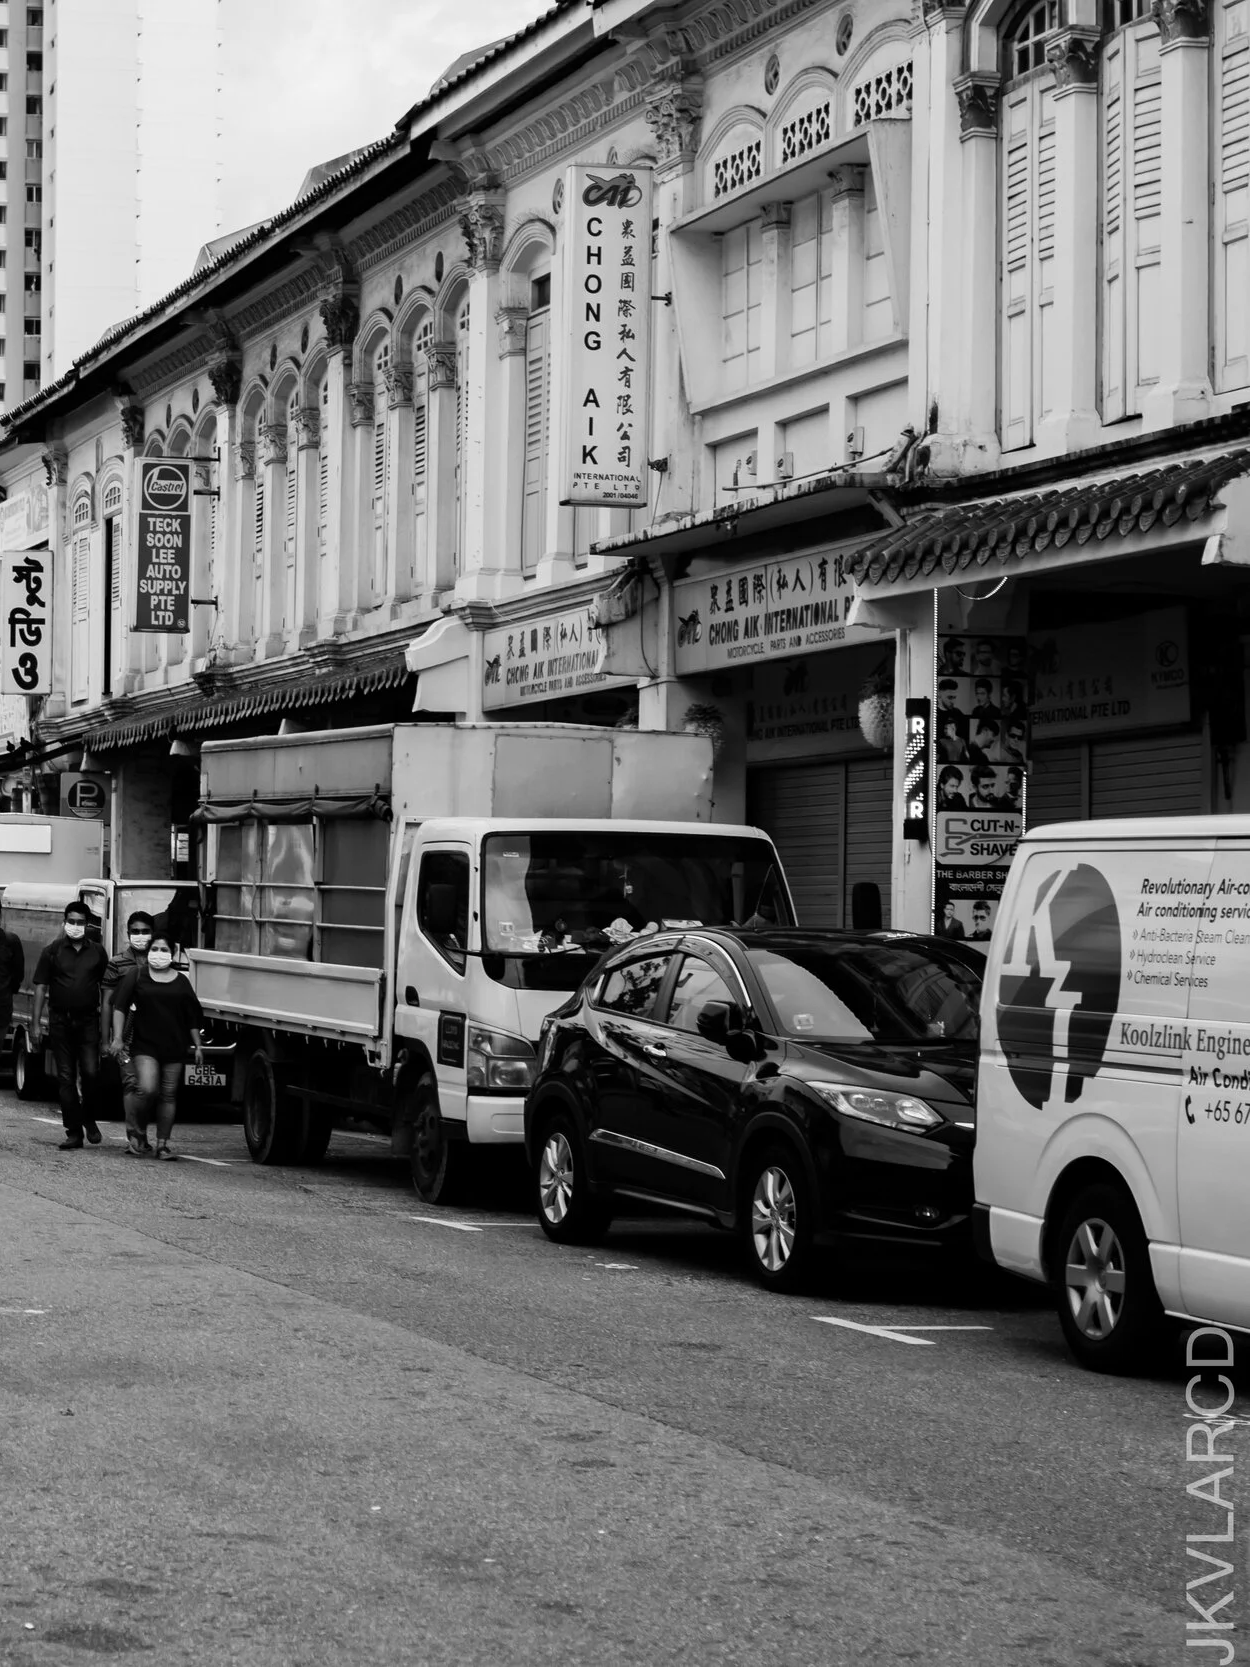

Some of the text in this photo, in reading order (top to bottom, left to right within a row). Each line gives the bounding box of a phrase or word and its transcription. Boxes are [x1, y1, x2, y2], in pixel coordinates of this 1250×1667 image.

[582, 216, 603, 465] CHONG AIK
[573, 472, 641, 483] INTERNATIONAL
[147, 517, 181, 533] TECK
[146, 533, 182, 548] SOON
[152, 548, 175, 563] LEE
[146, 564, 181, 579] AUTO
[139, 579, 186, 595] SUPPLY
[150, 595, 175, 610] PTE
[151, 610, 174, 626] LTD
[709, 619, 739, 646] CHONG
[743, 615, 760, 640] AIK
[764, 600, 839, 636] INTERNATIONAL
[727, 627, 846, 659] MOTORCYCLE PARTS AND ACCESSORIES
[506, 664, 529, 686] CHONG
[533, 657, 544, 681] AIK
[1091, 702, 1109, 718] PTE
[1111, 700, 1130, 717] LTD
[969, 843, 1018, 857] SHAVE
[936, 869, 1009, 880] THE BARBER SH
[1141, 877, 1250, 900] Revolutionary Air-co
[1137, 902, 1152, 917] Air
[1154, 901, 1217, 923] conditioning
[1140, 928, 1193, 943] Anti-Bacteria
[1196, 930, 1223, 944] Steam
[1136, 948, 1216, 967] Hydroclean Service
[1134, 970, 1208, 988] Chemical Services
[1120, 1022, 1192, 1051] Koolzlink
[1188, 1065, 1209, 1086] Air
[1204, 1100, 1231, 1122] +65
